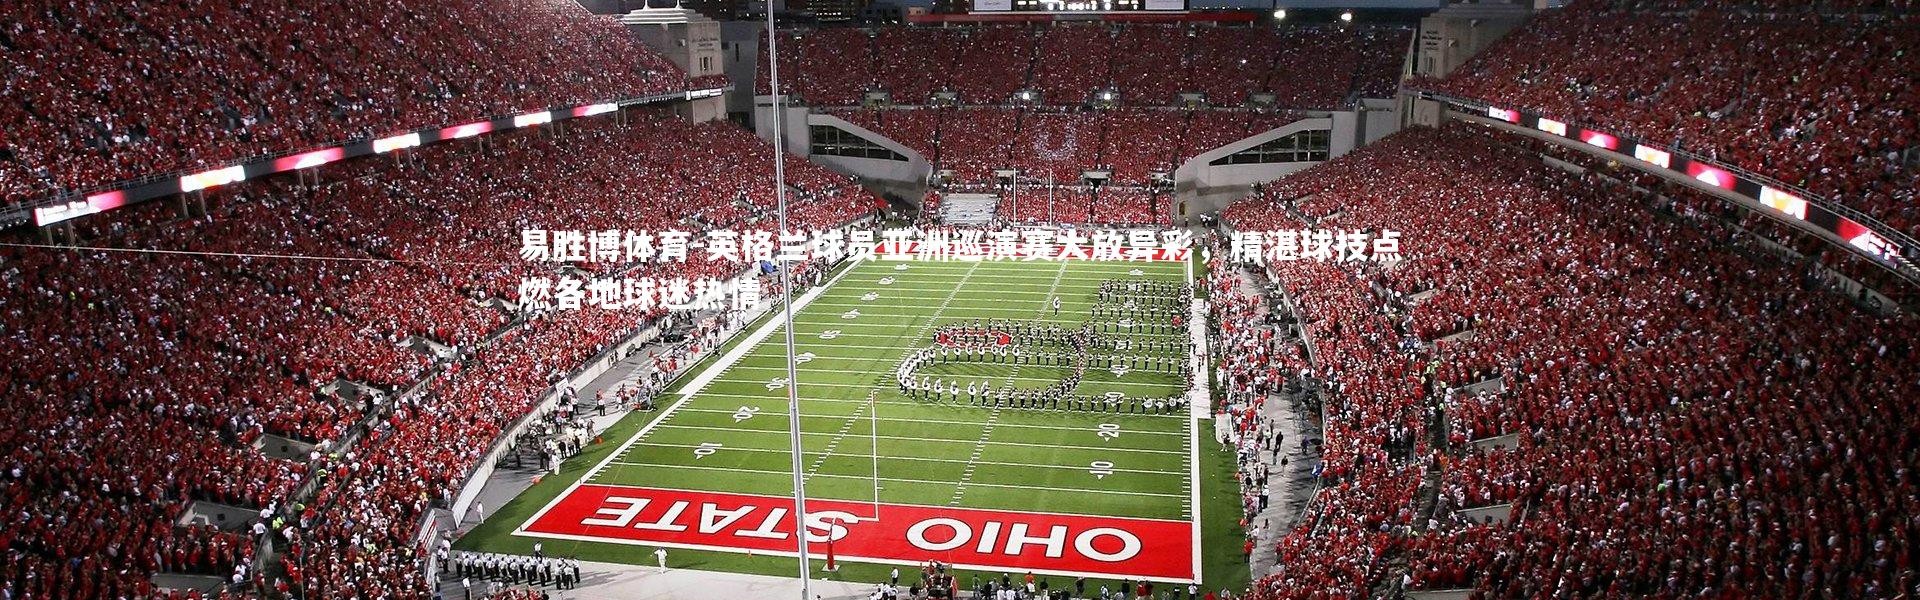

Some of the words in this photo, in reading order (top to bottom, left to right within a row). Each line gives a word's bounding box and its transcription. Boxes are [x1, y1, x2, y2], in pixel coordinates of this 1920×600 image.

[765, 376, 790, 389] 30
[732, 405, 761, 420] 20
[1097, 423, 1120, 438] 20
[693, 442, 723, 456] 10
[1088, 460, 1115, 475] 10
[580, 496, 859, 543] STATE
[905, 516, 1143, 563] OHIO
